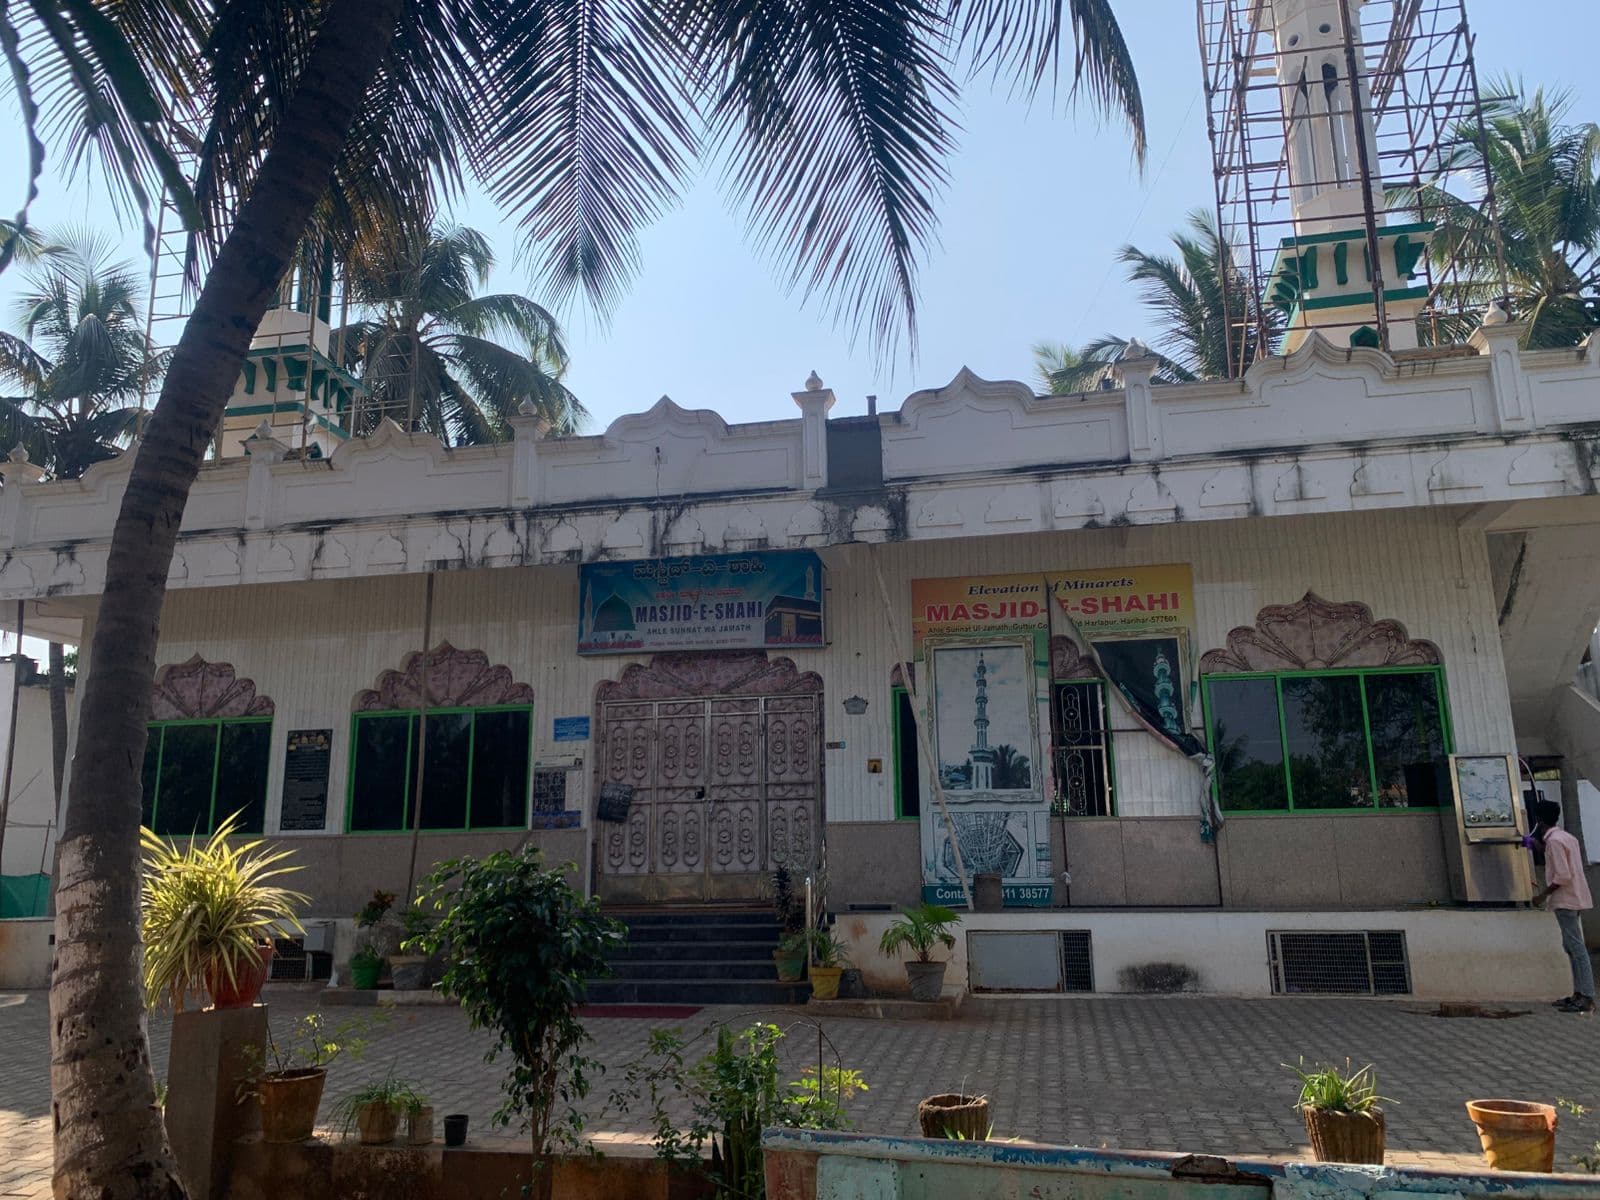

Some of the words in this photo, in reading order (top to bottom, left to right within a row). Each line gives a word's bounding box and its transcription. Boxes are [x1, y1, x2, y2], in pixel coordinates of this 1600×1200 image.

[968, 583, 1039, 596] Elevation
[1063, 577, 1134, 591] Minarets
[635, 601, 762, 623] MASJID-E-SHAHI
[1002, 888, 1015, 899] 11
[1019, 887, 1049, 899] 38577
